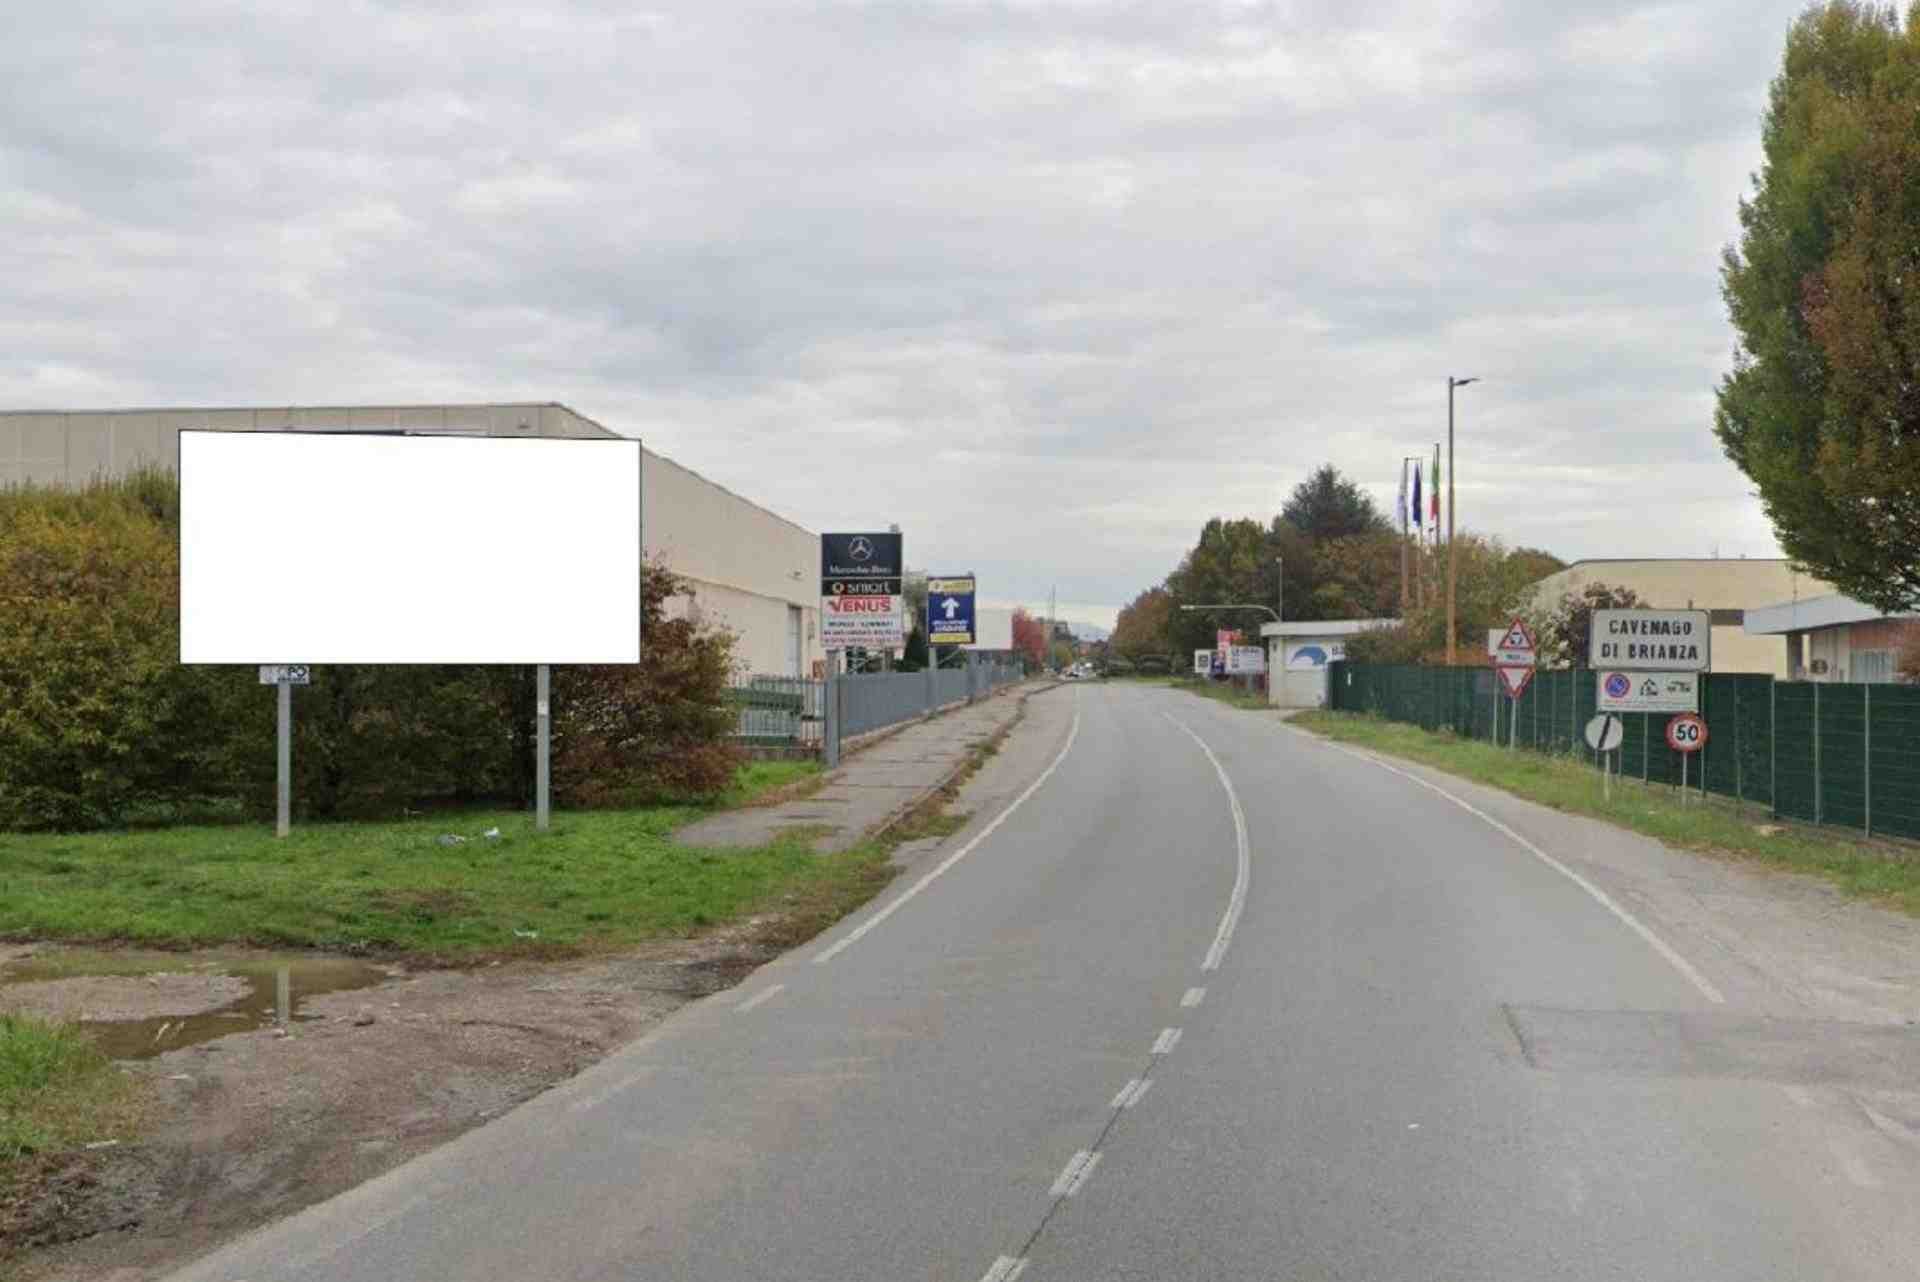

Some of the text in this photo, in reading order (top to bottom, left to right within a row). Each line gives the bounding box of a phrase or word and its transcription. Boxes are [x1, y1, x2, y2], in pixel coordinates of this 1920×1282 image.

[828, 595, 891, 612] VENUS
[1608, 619, 1692, 635] CAVENAGO
[1601, 644, 1698, 660] DI BRIANZA
[1676, 724, 1698, 741] 50
